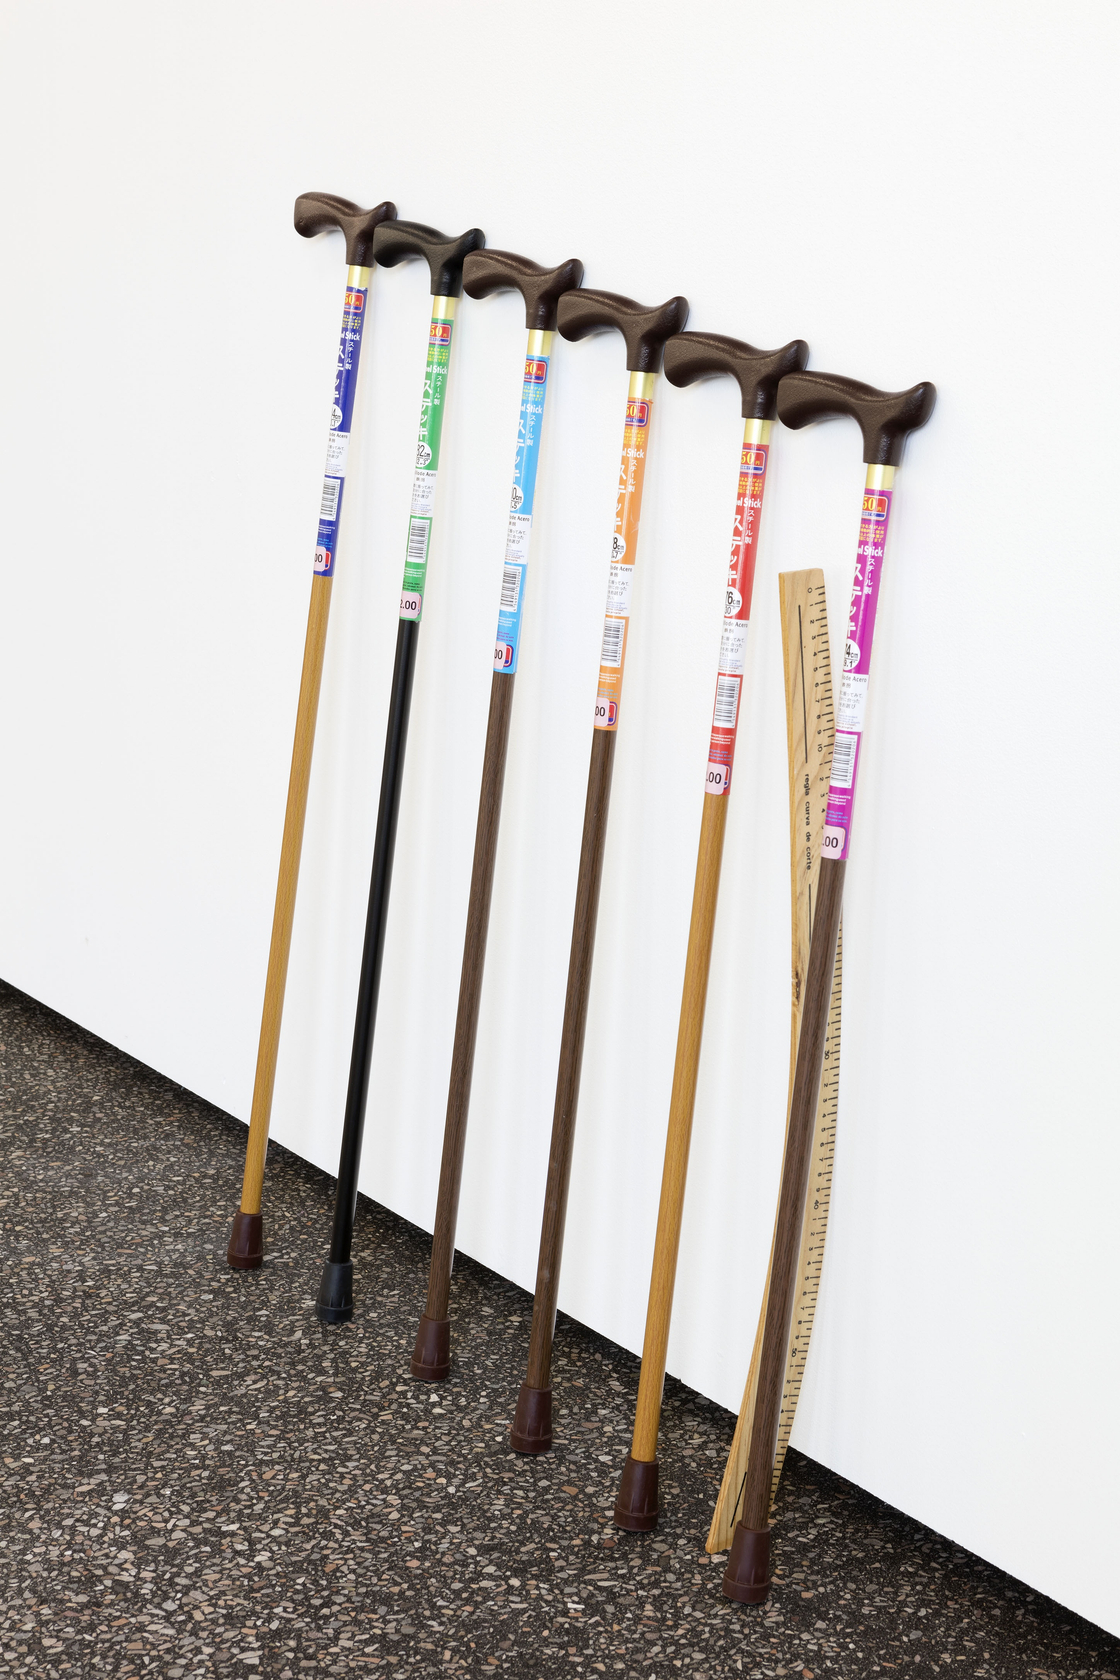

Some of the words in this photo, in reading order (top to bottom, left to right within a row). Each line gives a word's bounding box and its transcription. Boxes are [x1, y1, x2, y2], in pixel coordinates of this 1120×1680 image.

[345, 331, 361, 341] Stick
[432, 365, 448, 374] Stick
[526, 404, 543, 414] Stick
[526, 414, 536, 446] スチール製
[627, 448, 644, 458] Stick
[628, 459, 637, 492] スチール製
[743, 497, 761, 508] Stick
[744, 509, 755, 545] スチール製
[863, 545, 883, 557] Stick
[863, 557, 875, 595] スチール製
[817, 743, 823, 752] 10
[806, 831, 811, 843] de
[824, 1049, 830, 1059] 30
[813, 1199, 819, 1210] 40
[791, 1347, 798, 1357] 50
